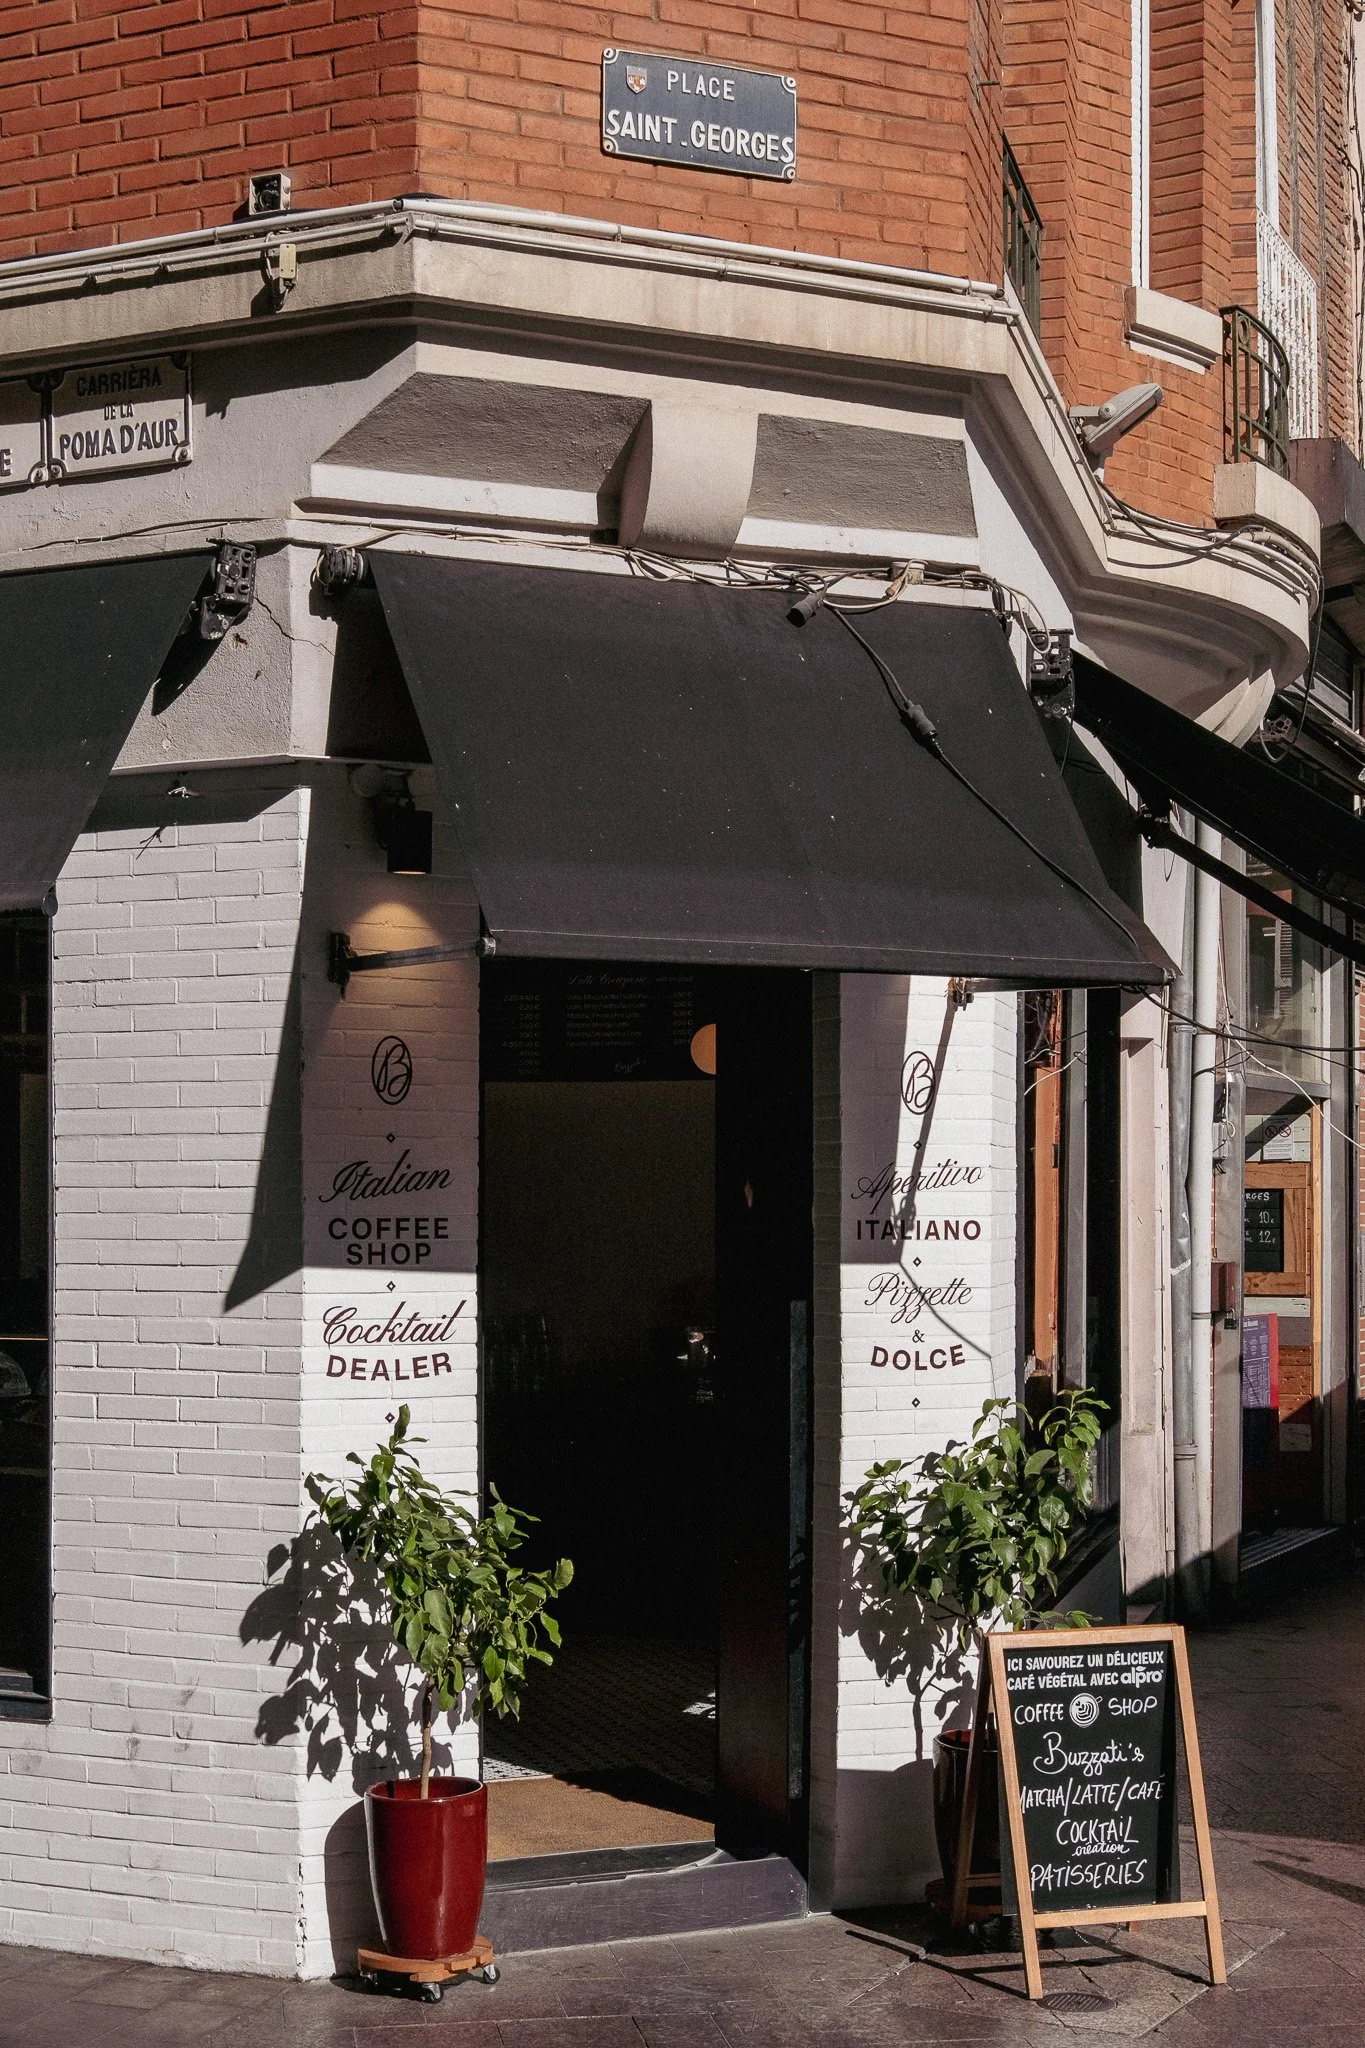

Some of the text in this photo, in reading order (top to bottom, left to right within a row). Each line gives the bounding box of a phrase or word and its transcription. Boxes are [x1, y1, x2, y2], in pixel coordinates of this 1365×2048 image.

[667, 70, 735, 102] PLACE
[76, 365, 162, 397] CARRIÈRA
[103, 402, 134, 421] DE LA
[59, 418, 179, 461] POMA D'AUR
[318, 1148, 454, 1203] Italian
[851, 1158, 985, 1215] Aperitivo
[328, 1217, 449, 1240] COFFEE
[857, 1219, 981, 1241] ITALIANO
[346, 1243, 431, 1265] SHOP
[864, 1271, 974, 1324] Pizzette
[322, 1299, 468, 1351] Cocktail
[911, 1329, 926, 1343] &
[326, 1352, 452, 1382] DEALER
[870, 1343, 966, 1371] DOLCE
[1007, 1650, 1165, 1672] ICI SAVOUREZ UN DÉLICIEUX
[1007, 1666, 1164, 1691] CAFÉ VÉGÉTAL AVEC alpro
[1014, 1695, 1158, 1725] COFFEE SHOP
[1033, 1731, 1145, 1777] Buzzati's
